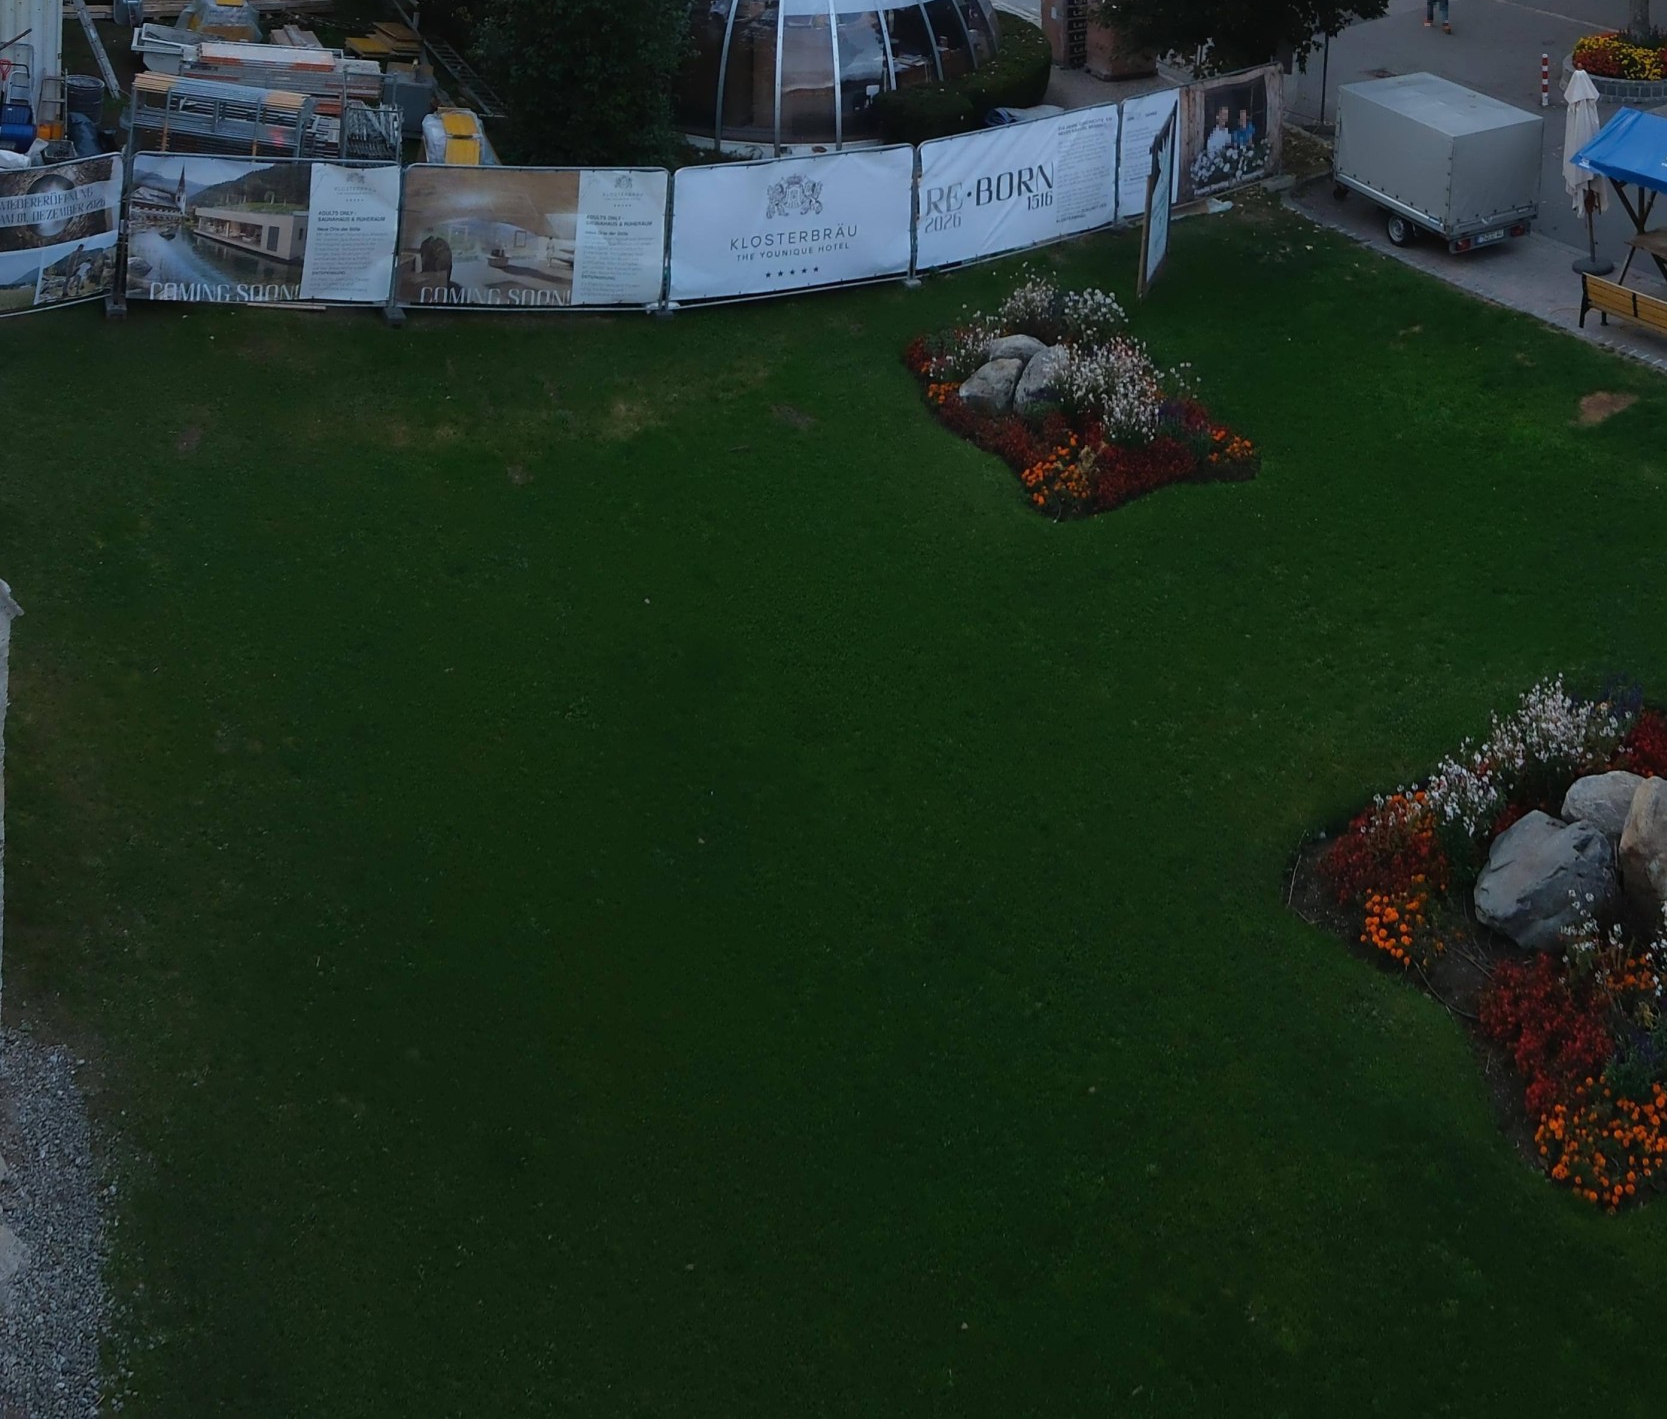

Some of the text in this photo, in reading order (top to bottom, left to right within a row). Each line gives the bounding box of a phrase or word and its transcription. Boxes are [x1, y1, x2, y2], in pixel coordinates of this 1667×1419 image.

[925, 211, 961, 233] 2026
[730, 222, 858, 251] KLOSTERBRÄU
[737, 241, 850, 262] THE YOUNIQUE HOTEL
